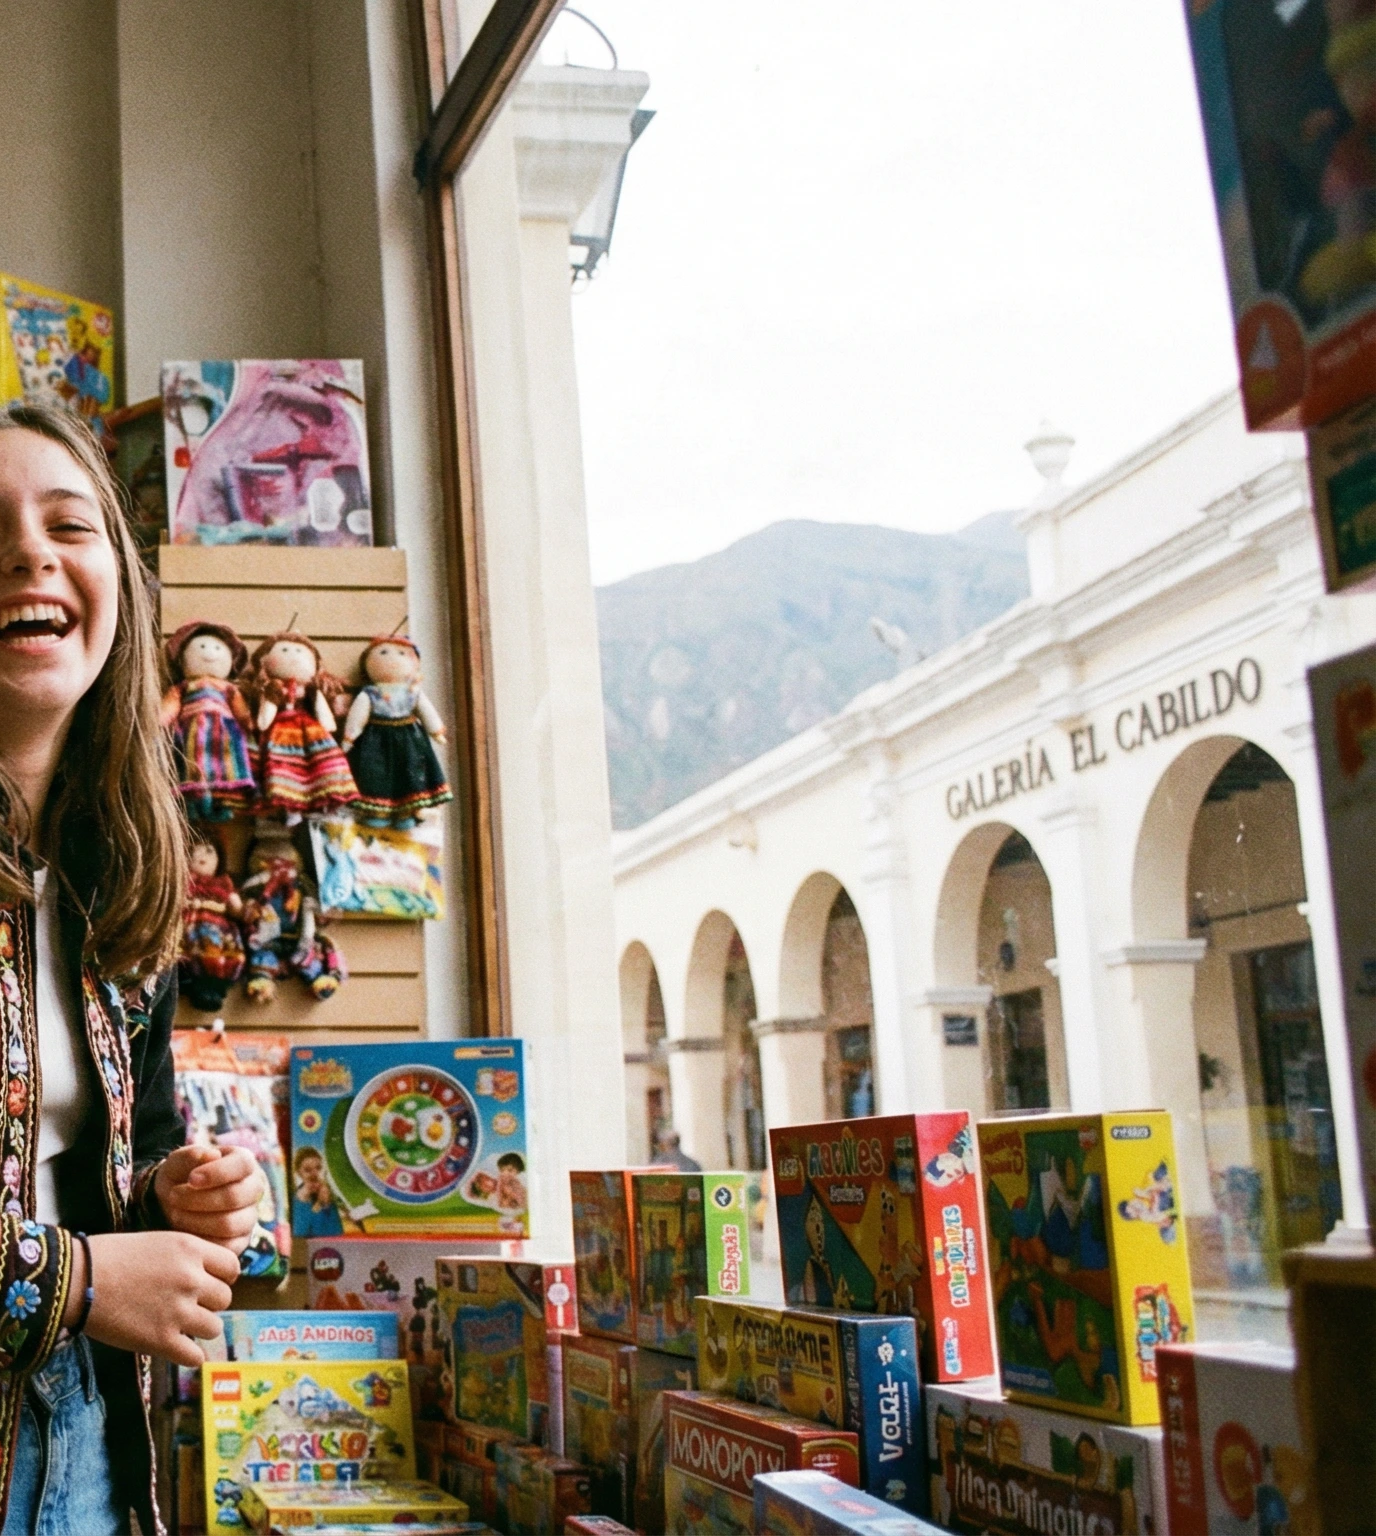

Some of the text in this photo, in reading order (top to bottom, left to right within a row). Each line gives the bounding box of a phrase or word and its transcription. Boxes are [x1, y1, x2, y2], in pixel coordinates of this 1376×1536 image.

[946, 657, 1262, 821] GALERÍA EL CABILDO
